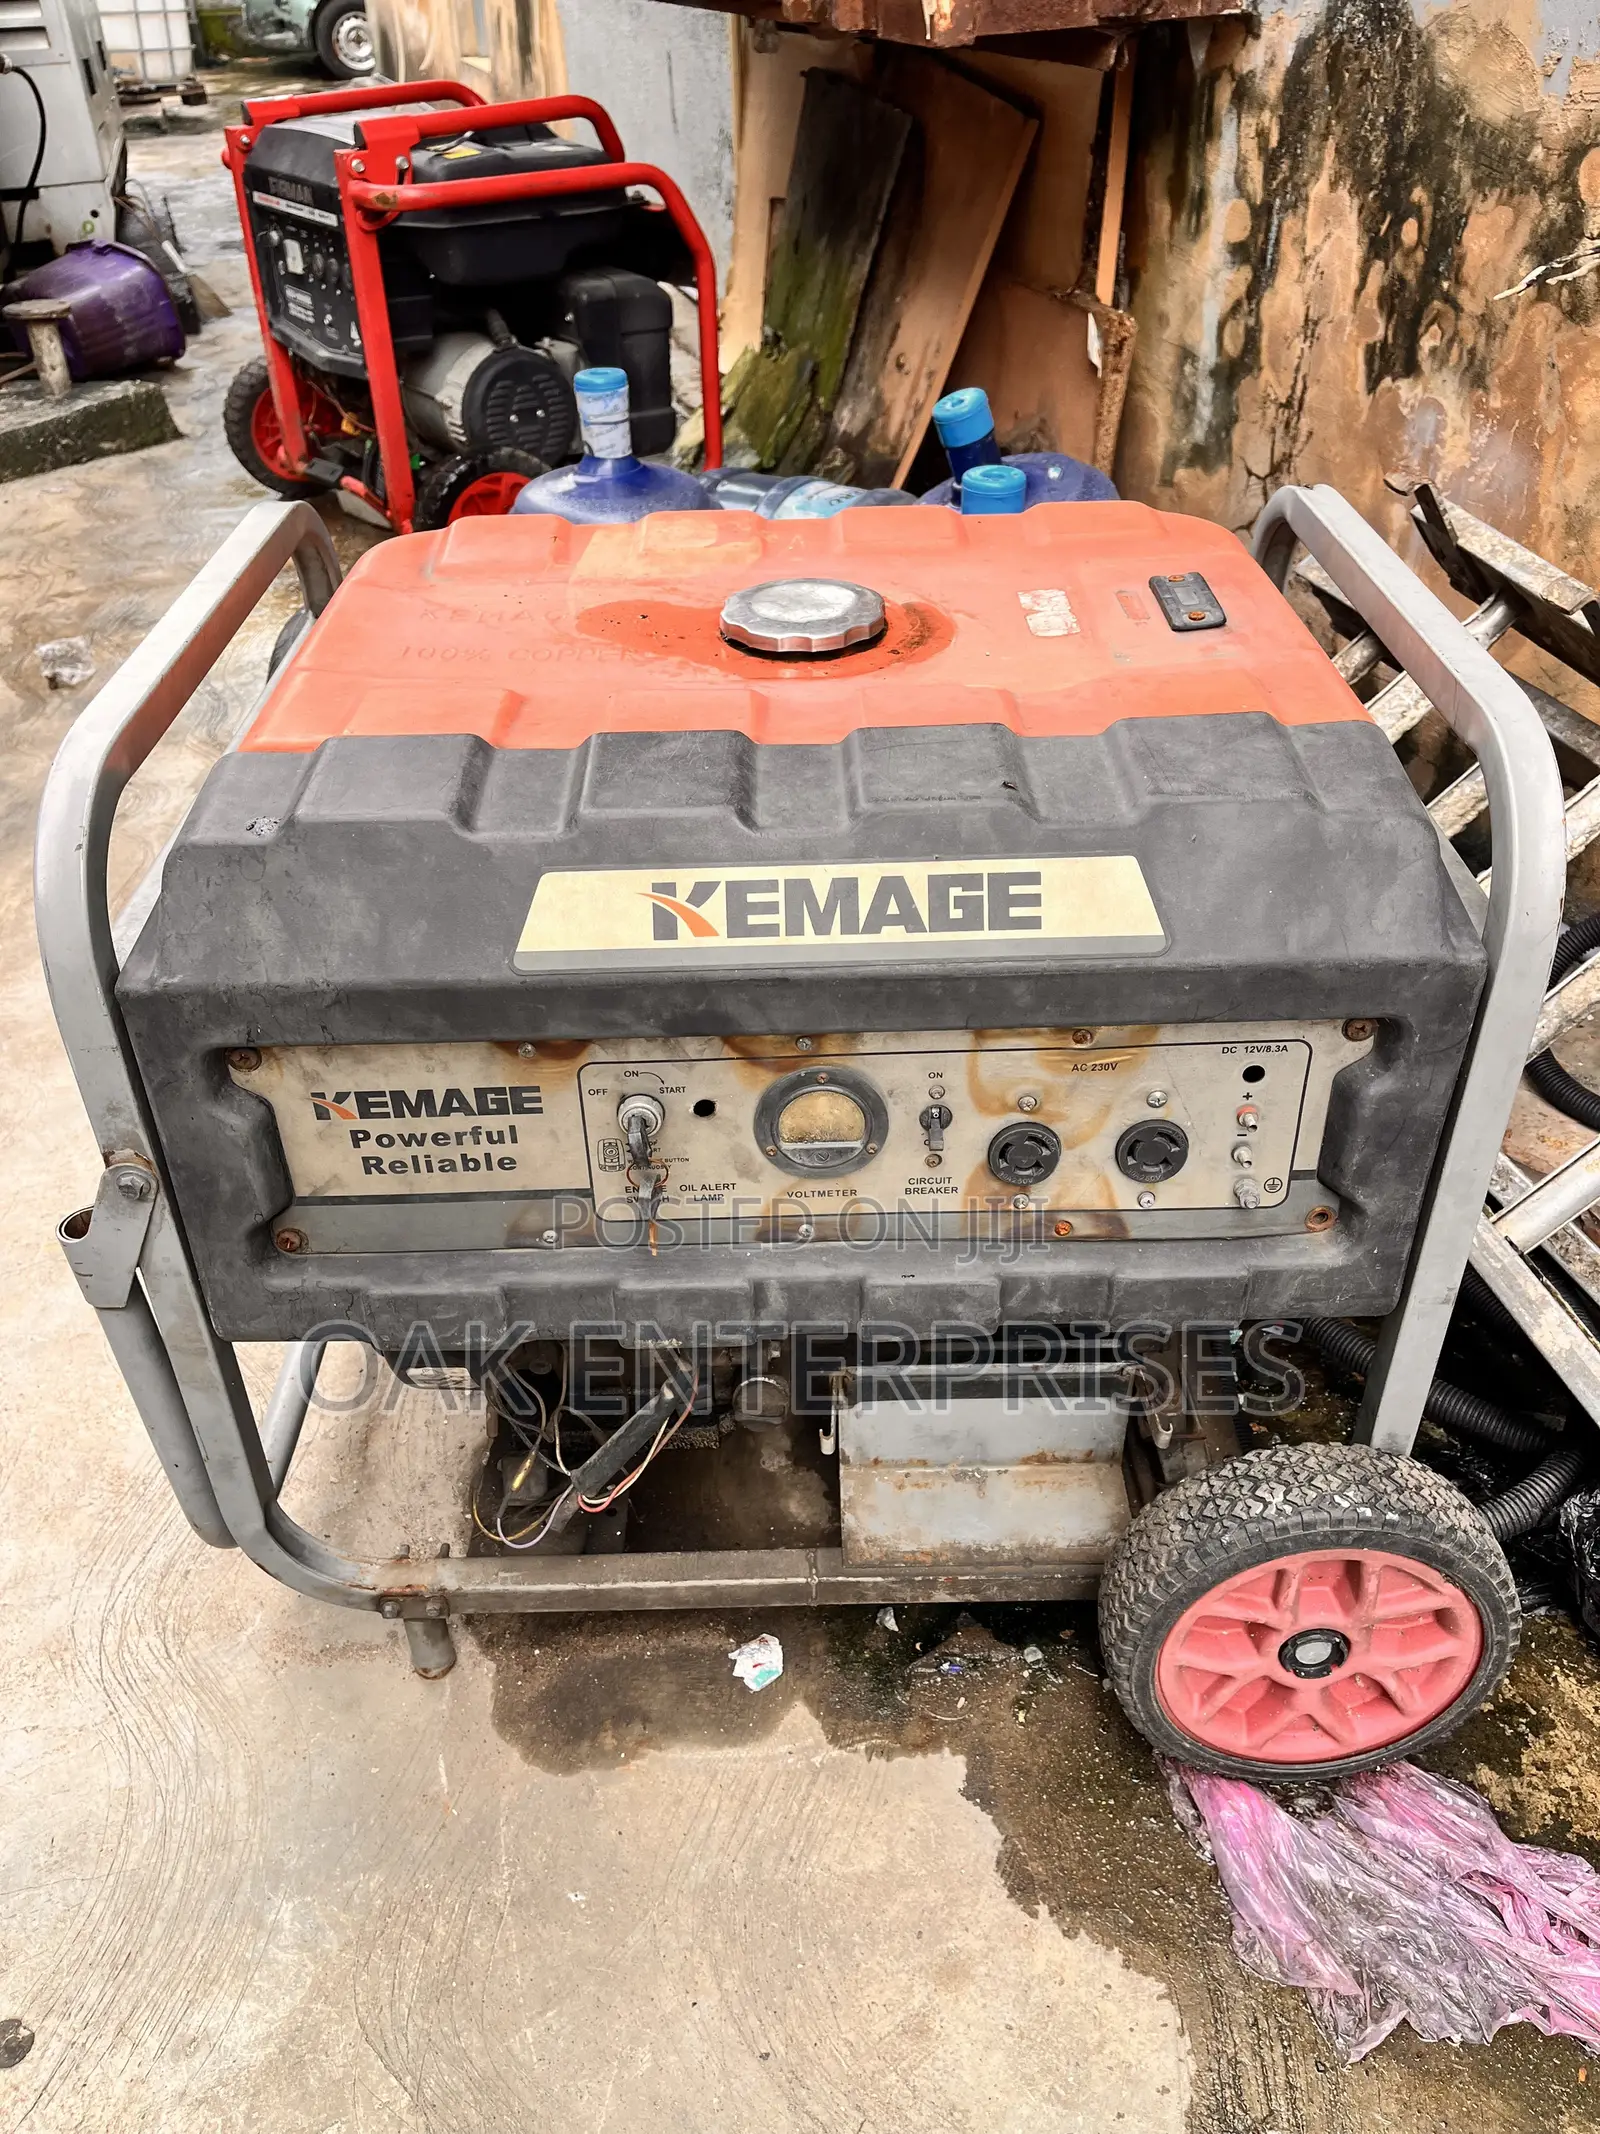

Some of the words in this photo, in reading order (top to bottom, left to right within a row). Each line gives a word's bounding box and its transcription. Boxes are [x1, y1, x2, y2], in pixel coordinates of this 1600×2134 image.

[507, 647, 641, 664] COPPER
[636, 871, 1041, 941] KEMAGE
[1221, 1046, 1238, 1054] DC
[1243, 1045, 1289, 1054] 12V/8.3A
[1071, 1063, 1088, 1072] AC
[1090, 1062, 1119, 1072] 230V
[928, 1071, 943, 1079] ON
[588, 1088, 608, 1096] OFF
[659, 1086, 687, 1095] START
[307, 1086, 544, 1121] KEMAGE
[349, 1125, 519, 1149] Powerful
[361, 1153, 518, 1176] Reliable
[908, 1176, 953, 1185] CIRCUIT
[679, 1184, 698, 1192] OIL
[700, 1183, 737, 1192] ALERT
[904, 1186, 959, 1196] BREAKER
[693, 1193, 725, 1202] LAMP
[787, 1189, 858, 1199] VOLTMETER
